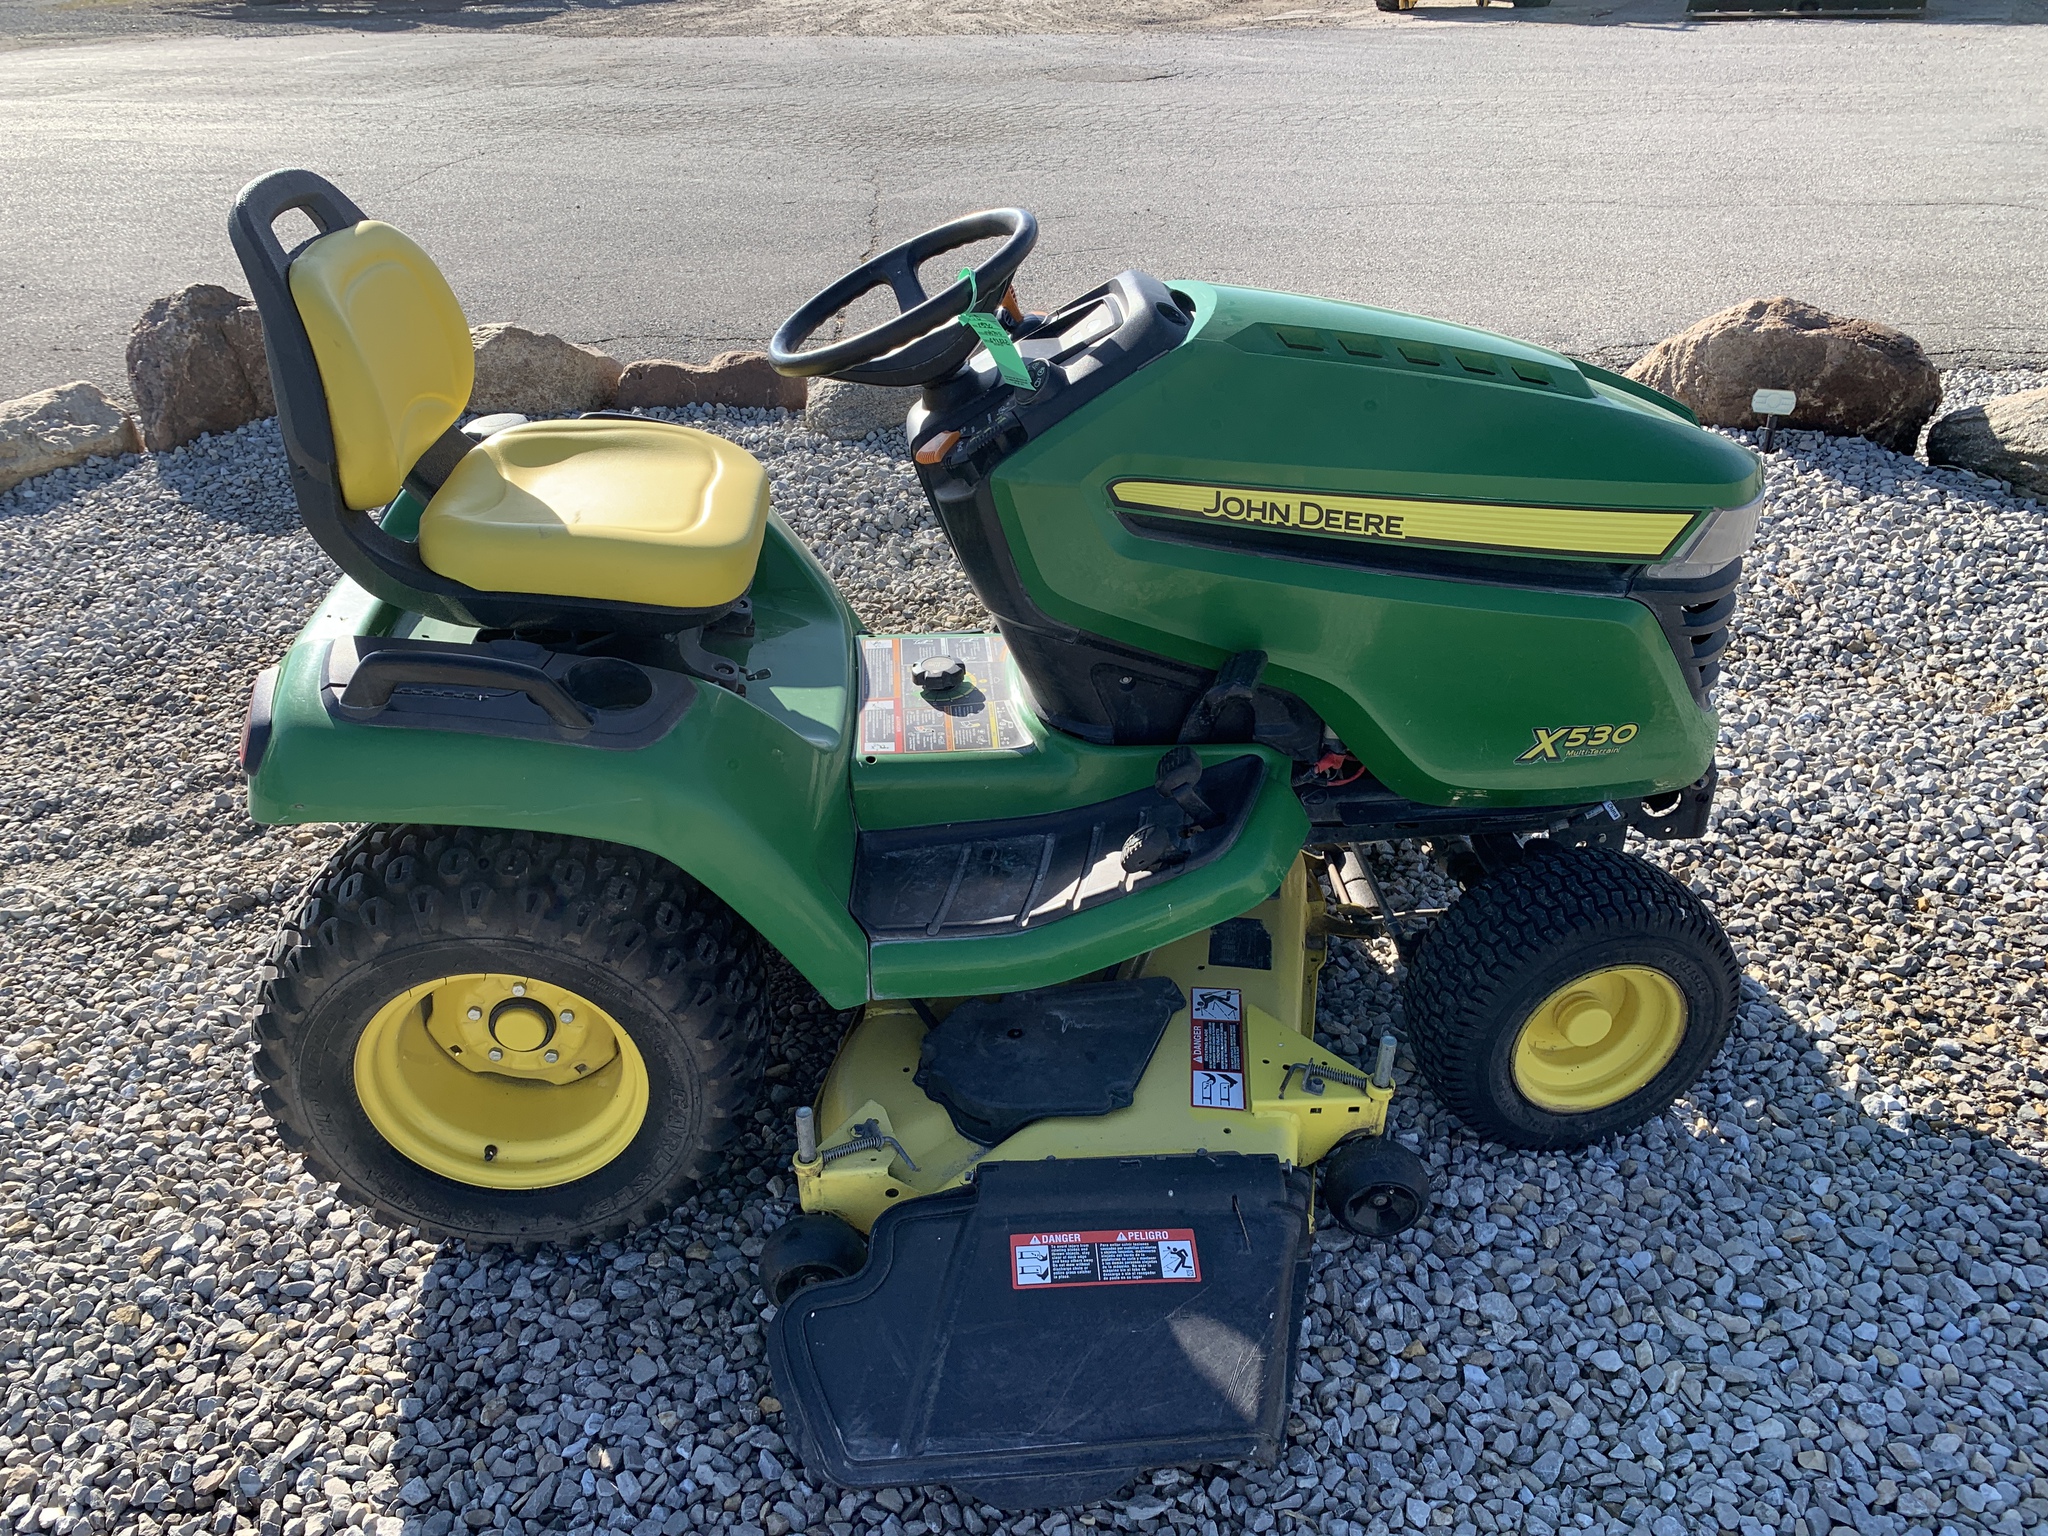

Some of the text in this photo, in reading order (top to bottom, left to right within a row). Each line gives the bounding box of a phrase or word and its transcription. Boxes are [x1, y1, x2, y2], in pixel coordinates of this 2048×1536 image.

[1203, 491, 1405, 536] JOHN DEERE
[1516, 723, 1639, 762] X530
[1607, 802, 1619, 818] China
[1657, 953, 1708, 995] CARLISLE
[1194, 1026, 1202, 1055] DANGER
[594, 1087, 688, 1216] CARLISLE
[1042, 1233, 1081, 1244] DANGER
[1128, 1231, 1169, 1240] PELIGRO
